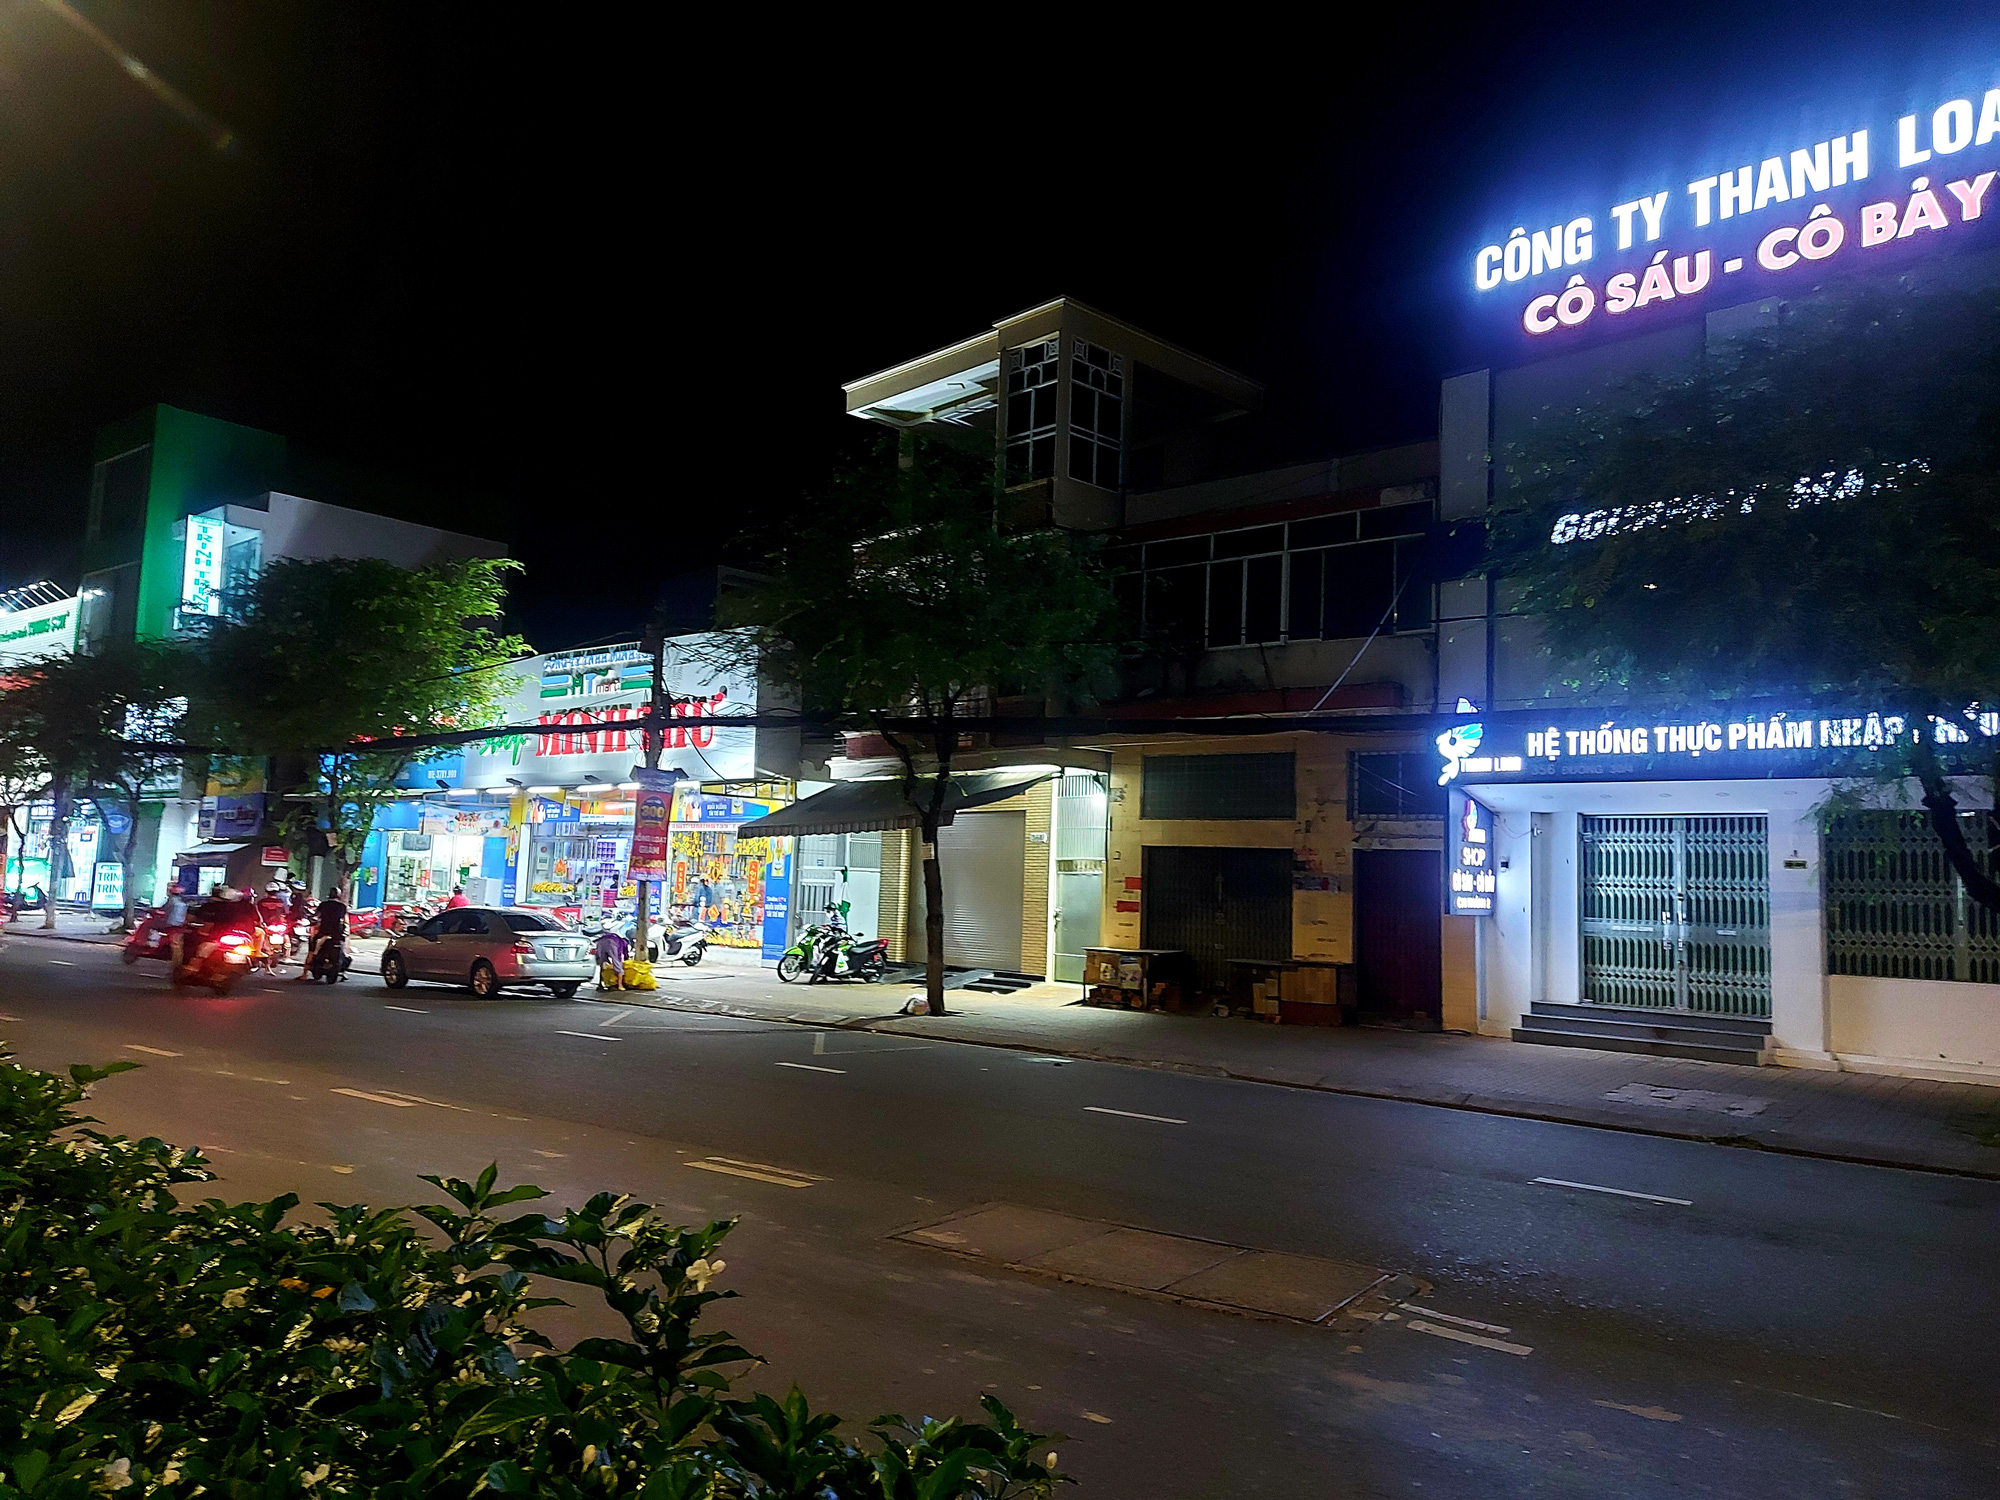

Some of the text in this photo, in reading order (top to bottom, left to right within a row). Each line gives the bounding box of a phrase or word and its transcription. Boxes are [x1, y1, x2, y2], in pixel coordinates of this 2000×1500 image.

[1475, 217, 1593, 291] CÔNG
[1610, 191, 1671, 251] TY
[1686, 129, 1870, 228] THANH
[1522, 269, 1596, 336] CÔ
[1604, 249, 1713, 314] SÁU
[1756, 208, 1846, 273] CÔ
[1860, 172, 1996, 249] BẢY
[535, 708, 631, 756] MINH
[1526, 726, 1561, 761] HỆ
[1565, 721, 1648, 757] THỐNG
[1653, 719, 1722, 759] THỰC
[1728, 712, 1813, 750] PHẨM
[1819, 710, 1906, 753] NHẬP
[1463, 847, 1487, 867] SHOP
